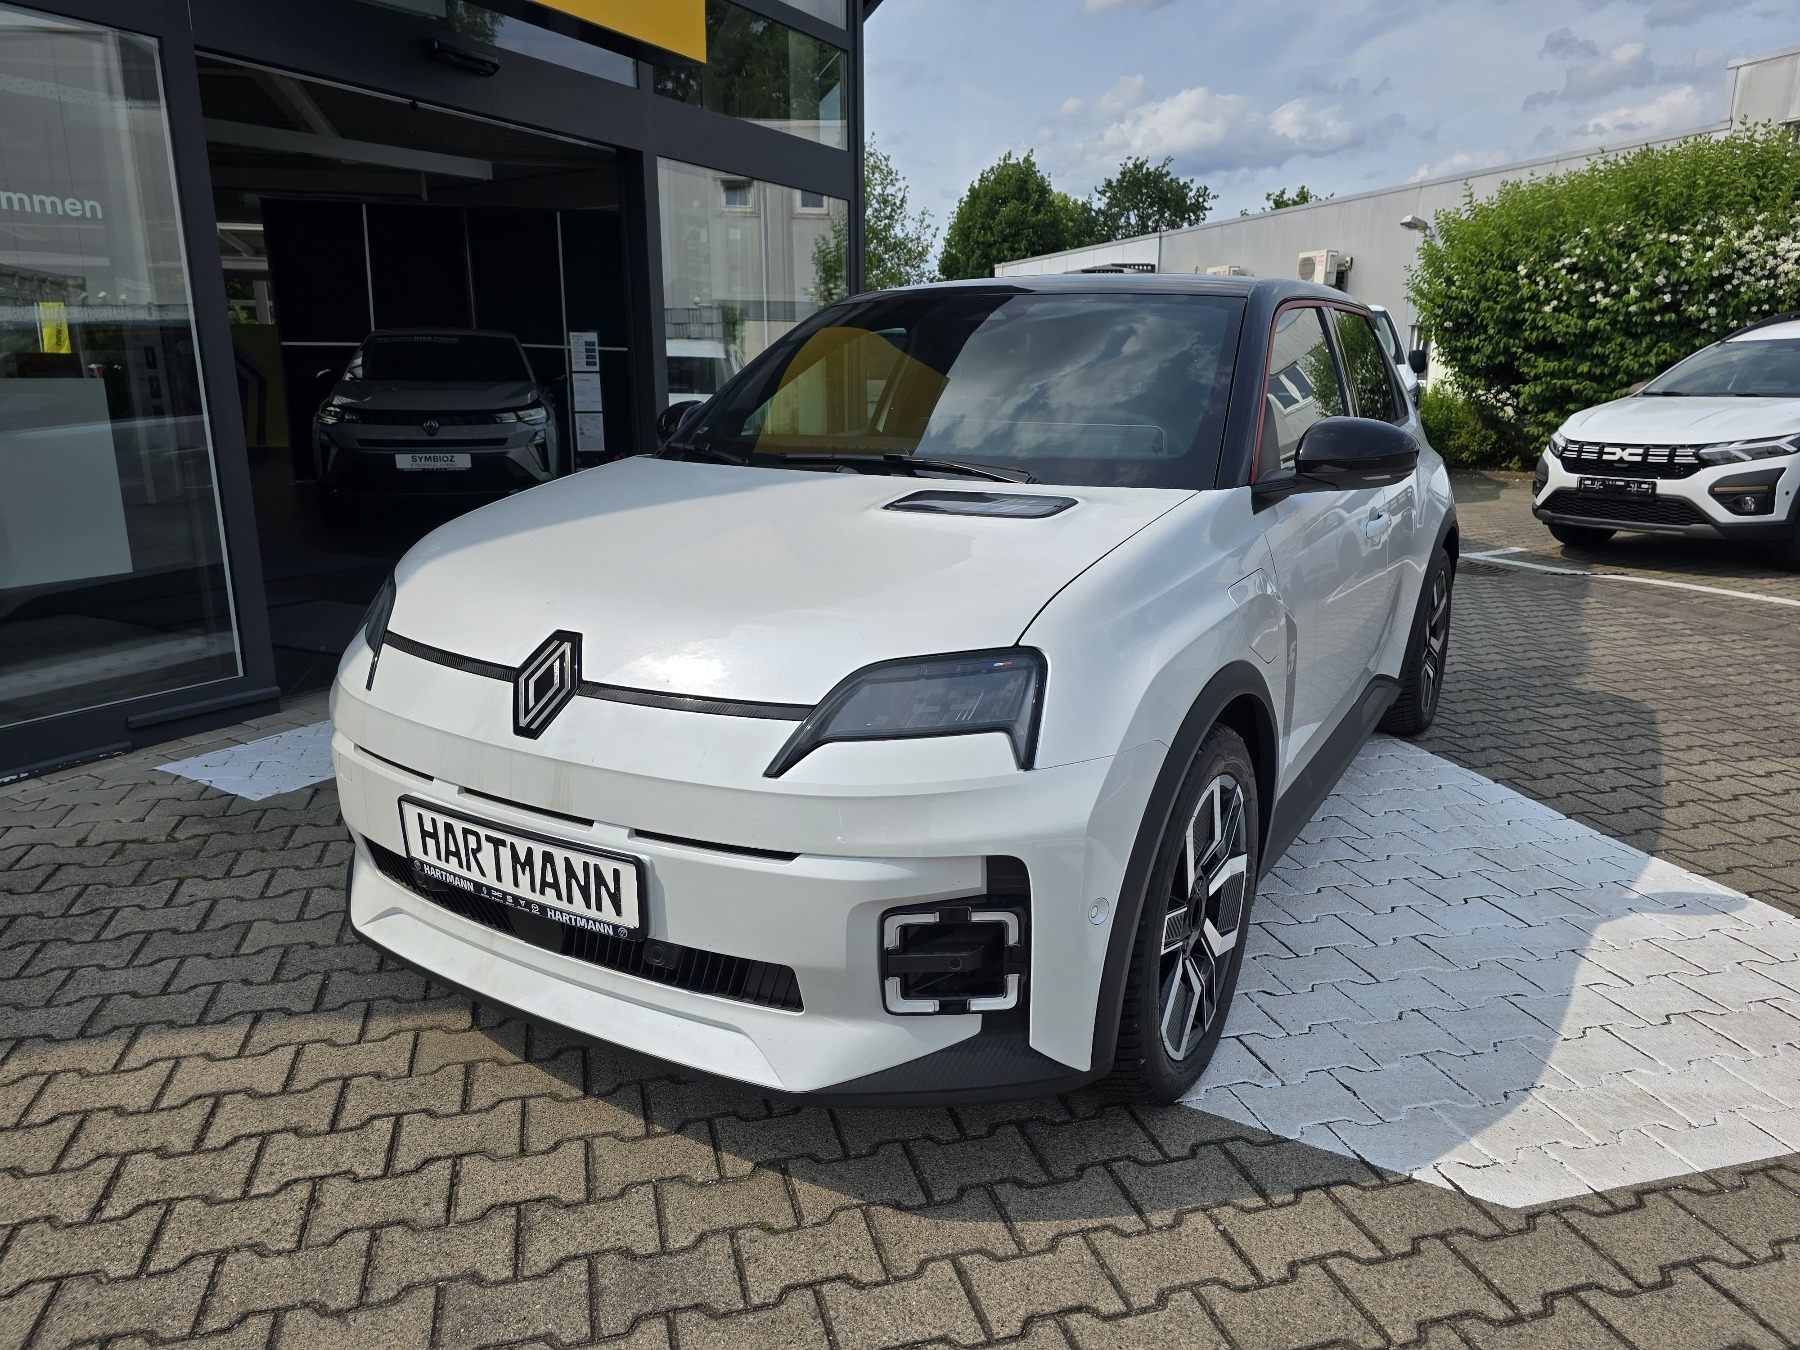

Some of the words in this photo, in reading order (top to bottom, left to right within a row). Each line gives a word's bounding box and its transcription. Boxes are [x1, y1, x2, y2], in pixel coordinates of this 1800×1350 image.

[411, 455, 455, 463] SYMBIOZ
[417, 811, 623, 917] HARTMANN
[423, 864, 475, 892] HARTMANN
[546, 907, 614, 936] HARTMANN
